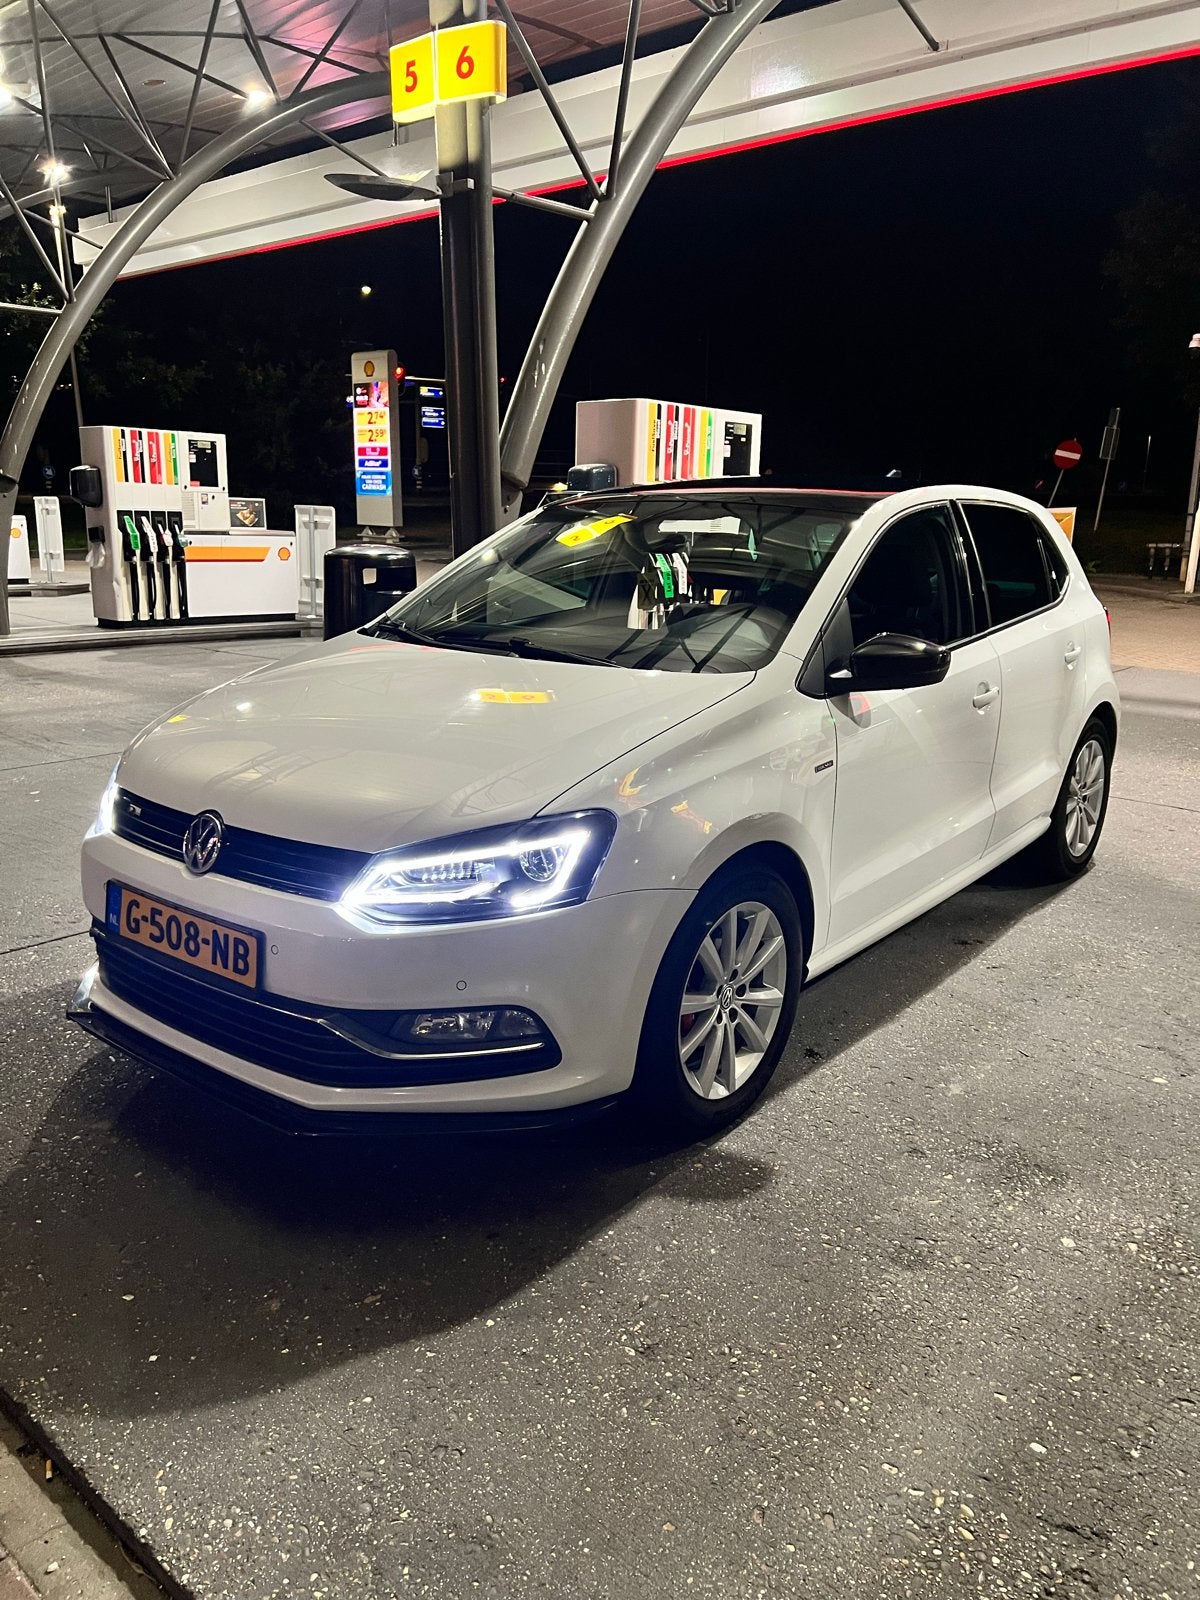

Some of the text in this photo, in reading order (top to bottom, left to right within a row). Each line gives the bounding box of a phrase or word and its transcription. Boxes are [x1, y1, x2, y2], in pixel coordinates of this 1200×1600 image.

[405, 59, 418, 93] 5
[455, 45, 475, 79] 6
[109, 913, 119, 926] NL
[126, 898, 250, 976] G-508-NB
